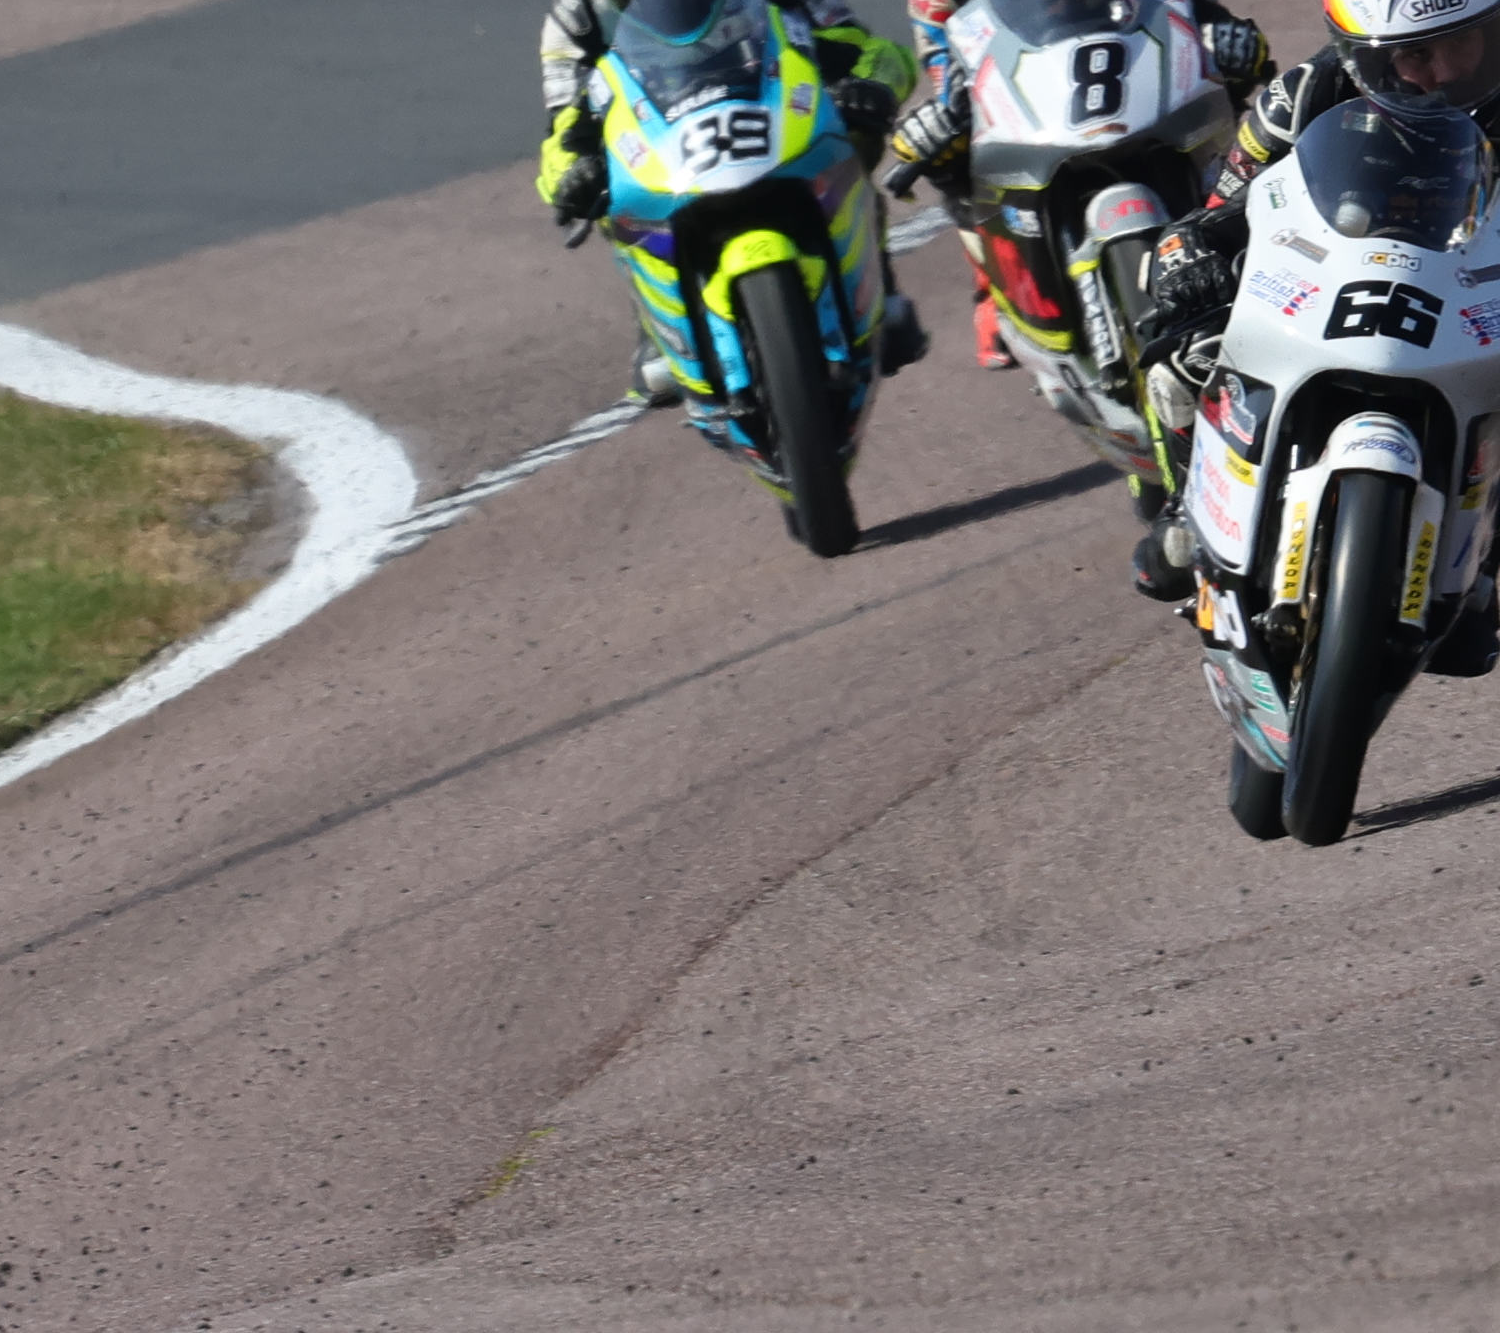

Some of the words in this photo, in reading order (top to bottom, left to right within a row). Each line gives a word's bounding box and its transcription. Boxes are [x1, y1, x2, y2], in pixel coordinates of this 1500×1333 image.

[1069, 39, 1126, 126] 8
[683, 109, 770, 175] 38
[1323, 280, 1444, 349] 66
